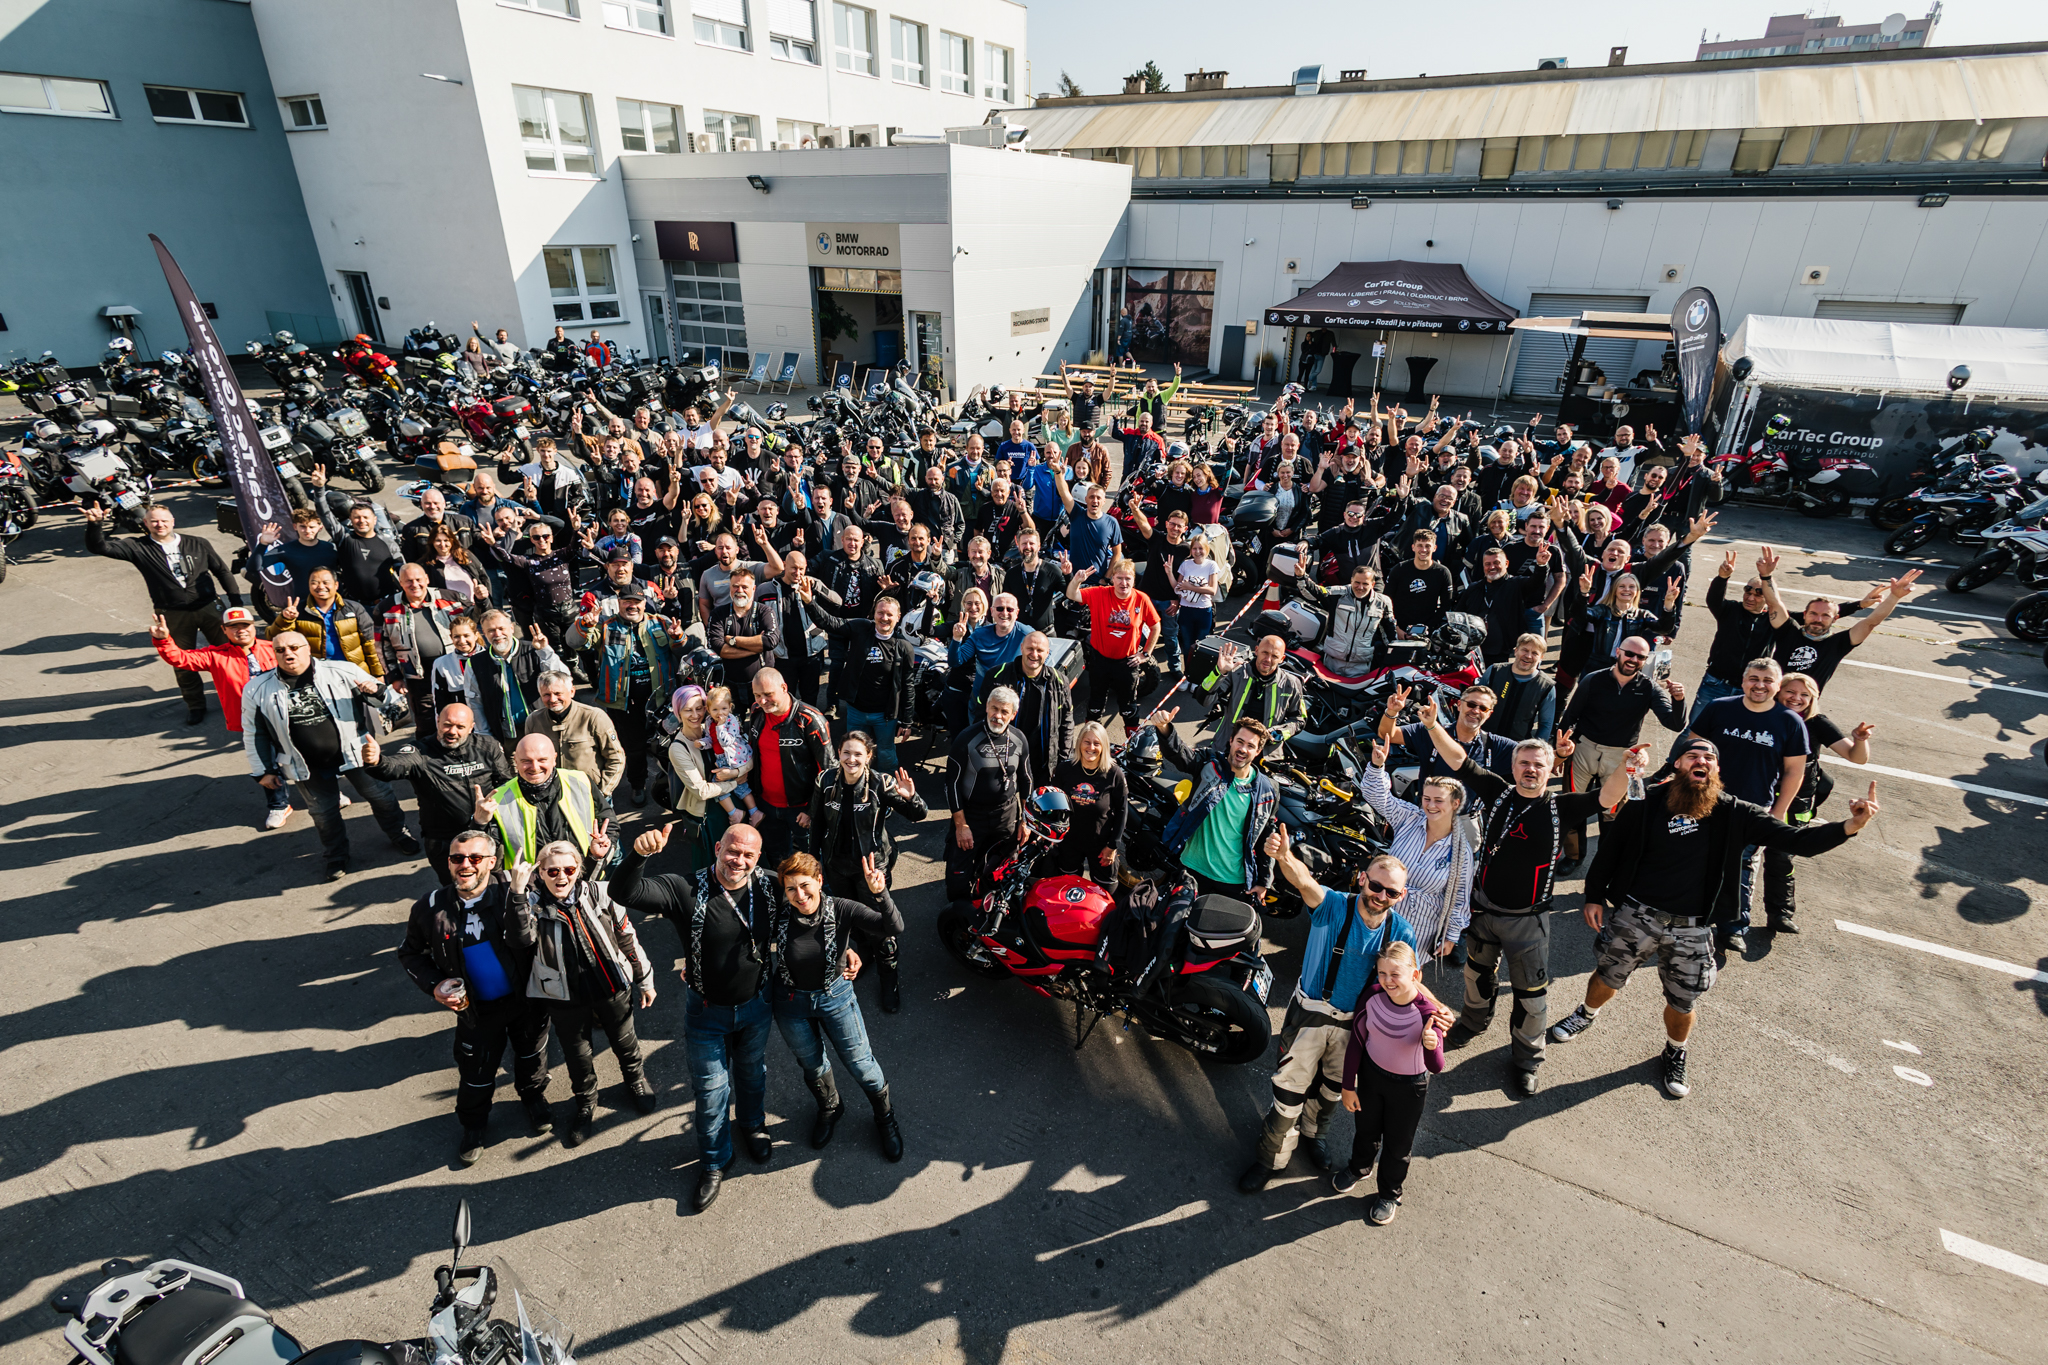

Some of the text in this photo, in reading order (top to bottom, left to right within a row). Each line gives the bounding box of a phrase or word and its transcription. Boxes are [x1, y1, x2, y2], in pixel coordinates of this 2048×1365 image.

[835, 233, 859, 244] BMW
[836, 245, 890, 257] MOTORRAD
[1364, 280, 1424, 291] CarTec Group
[1383, 289, 1406, 297] PRAHA
[1410, 293, 1444, 301] OLOMOUC
[1324, 316, 1348, 325] CarTec
[1348, 317, 1370, 326] Group
[1375, 318, 1397, 326] Rozdíl
[1398, 319, 1406, 328] je
[1412, 319, 1443, 328] přístupu
[1774, 429, 1883, 450] arTec Group
[1500, 681, 1510, 699] Klim
[1550, 799, 1558, 815] BMW
